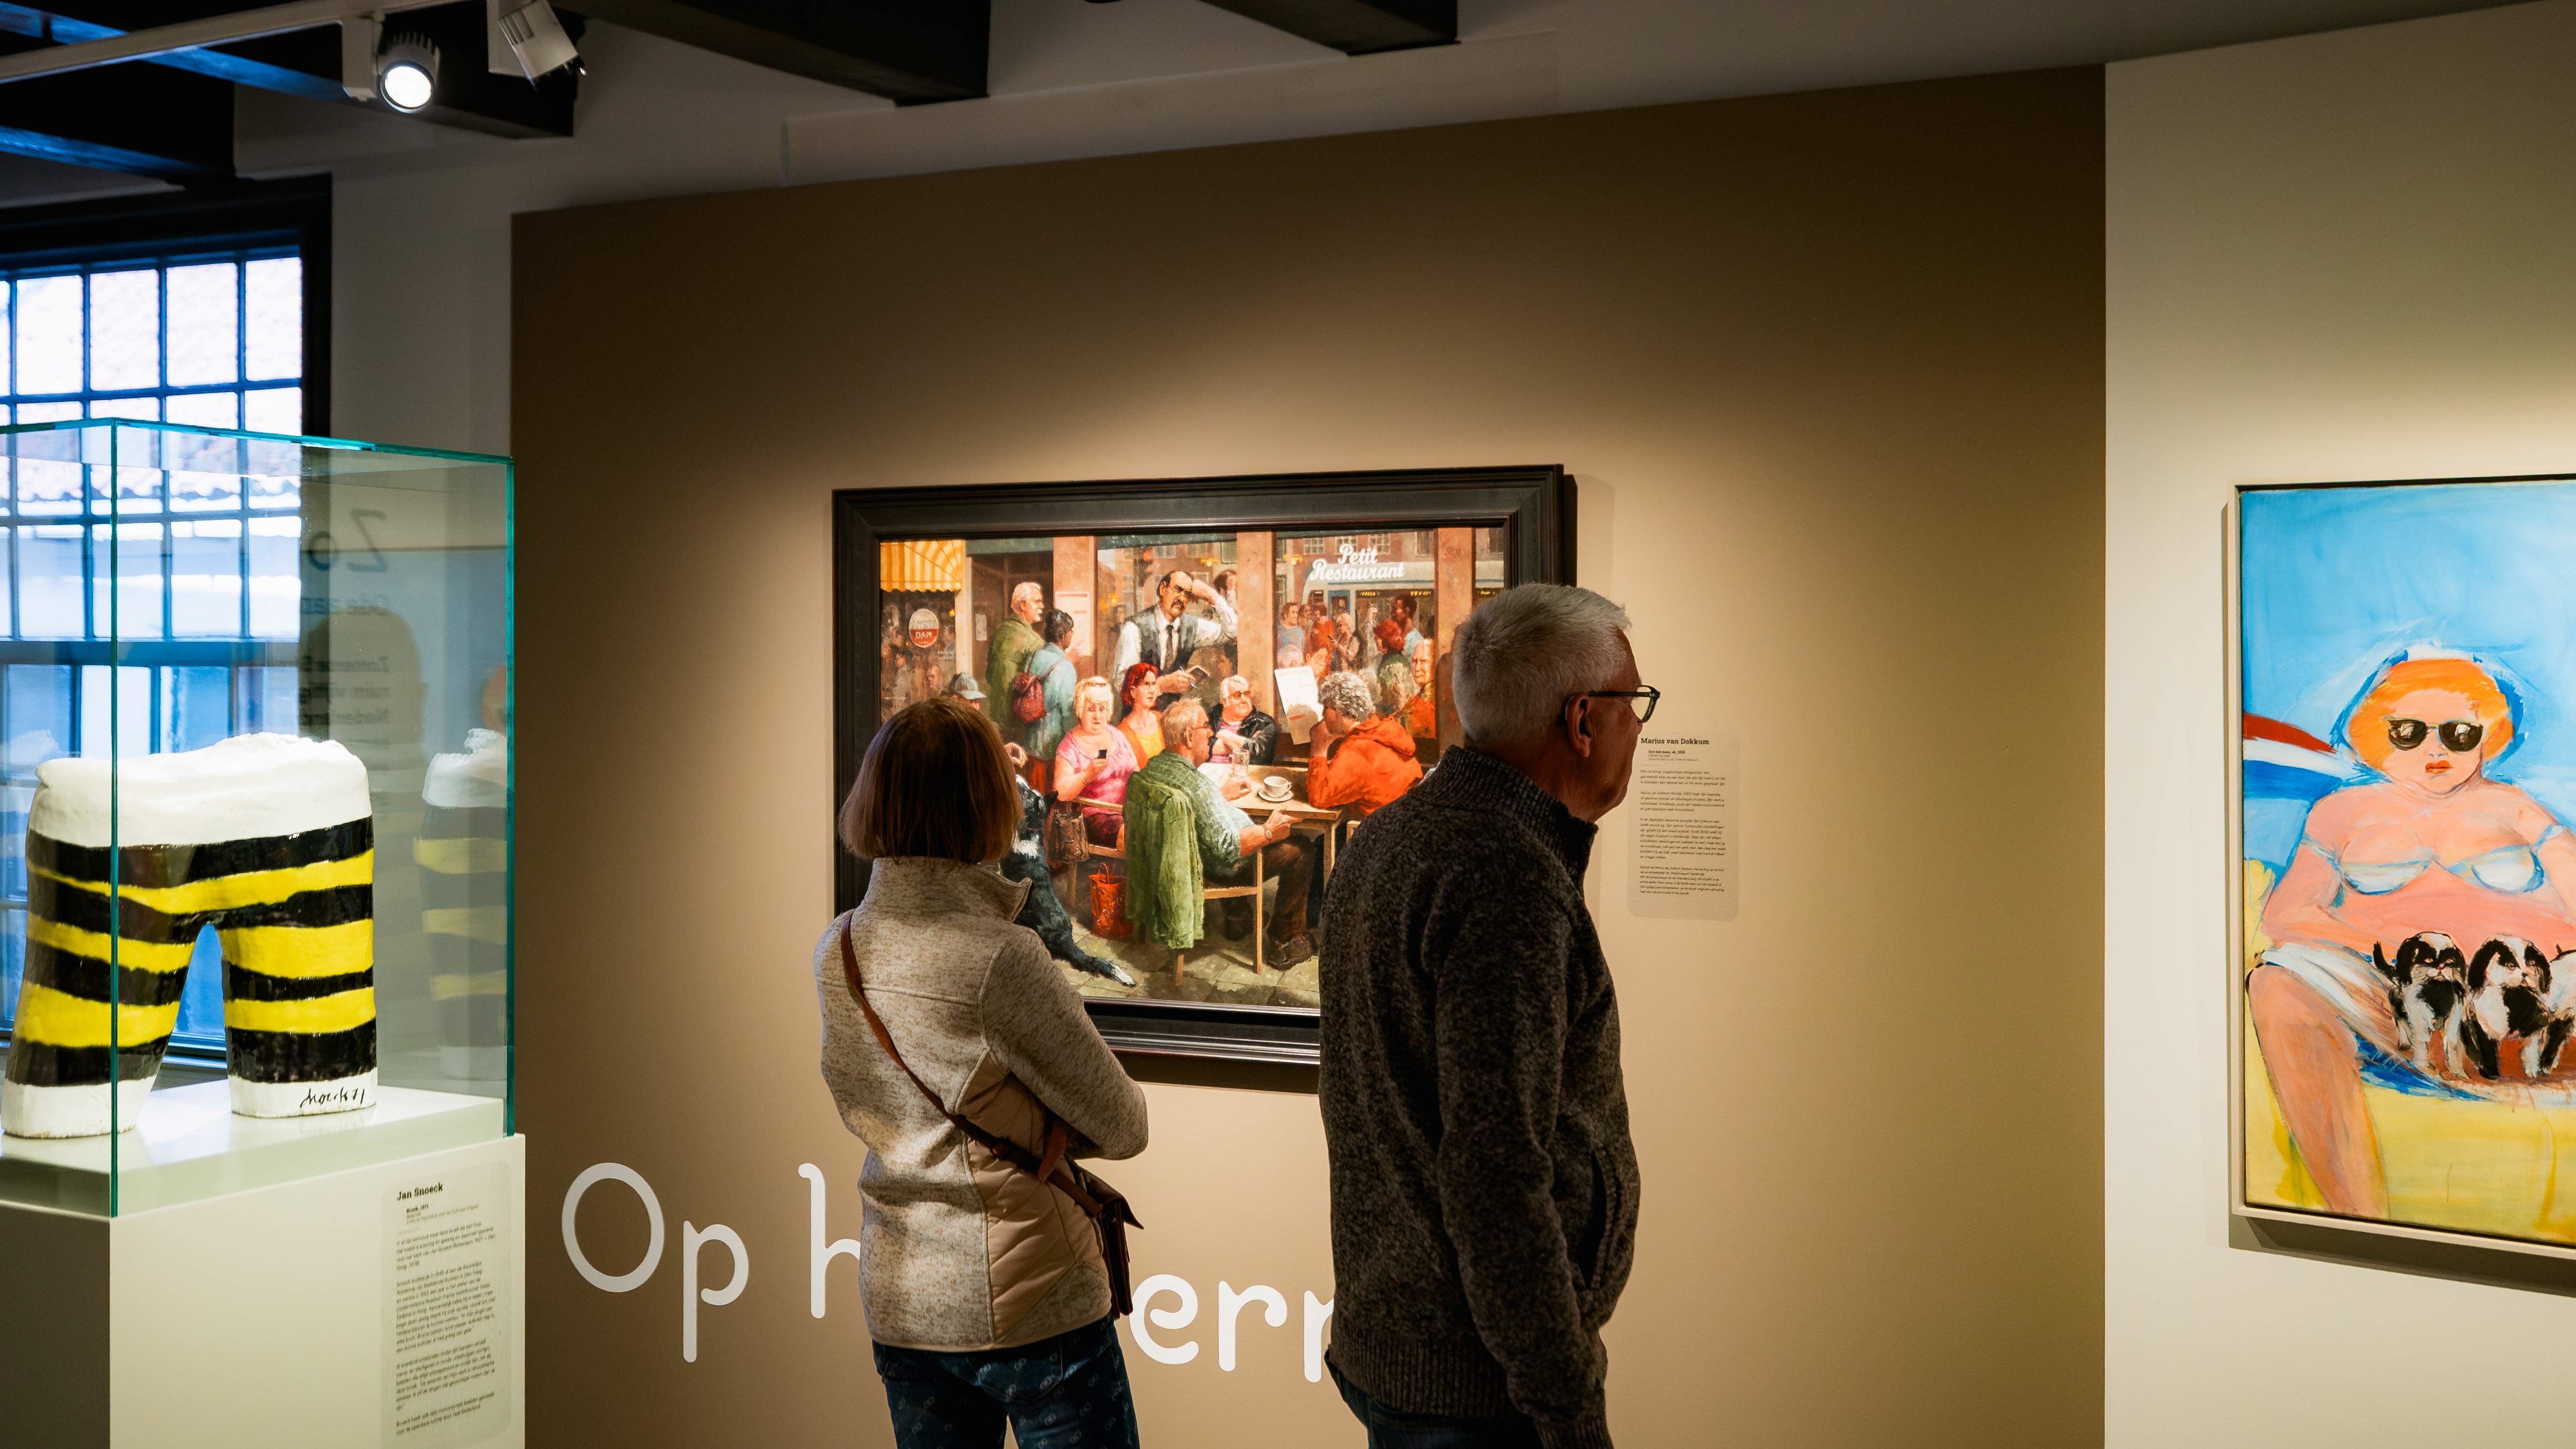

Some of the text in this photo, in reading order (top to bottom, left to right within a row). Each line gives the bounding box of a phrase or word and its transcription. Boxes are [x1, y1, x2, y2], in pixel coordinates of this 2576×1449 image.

[1337, 544, 1378, 565] Petit
[1310, 558, 1405, 580] Restaurant
[915, 631, 933, 639] DAM
[396, 1182, 444, 1201] Jan Snoeck
[562, 1162, 749, 1363] Op
[798, 1163, 861, 1318] h
